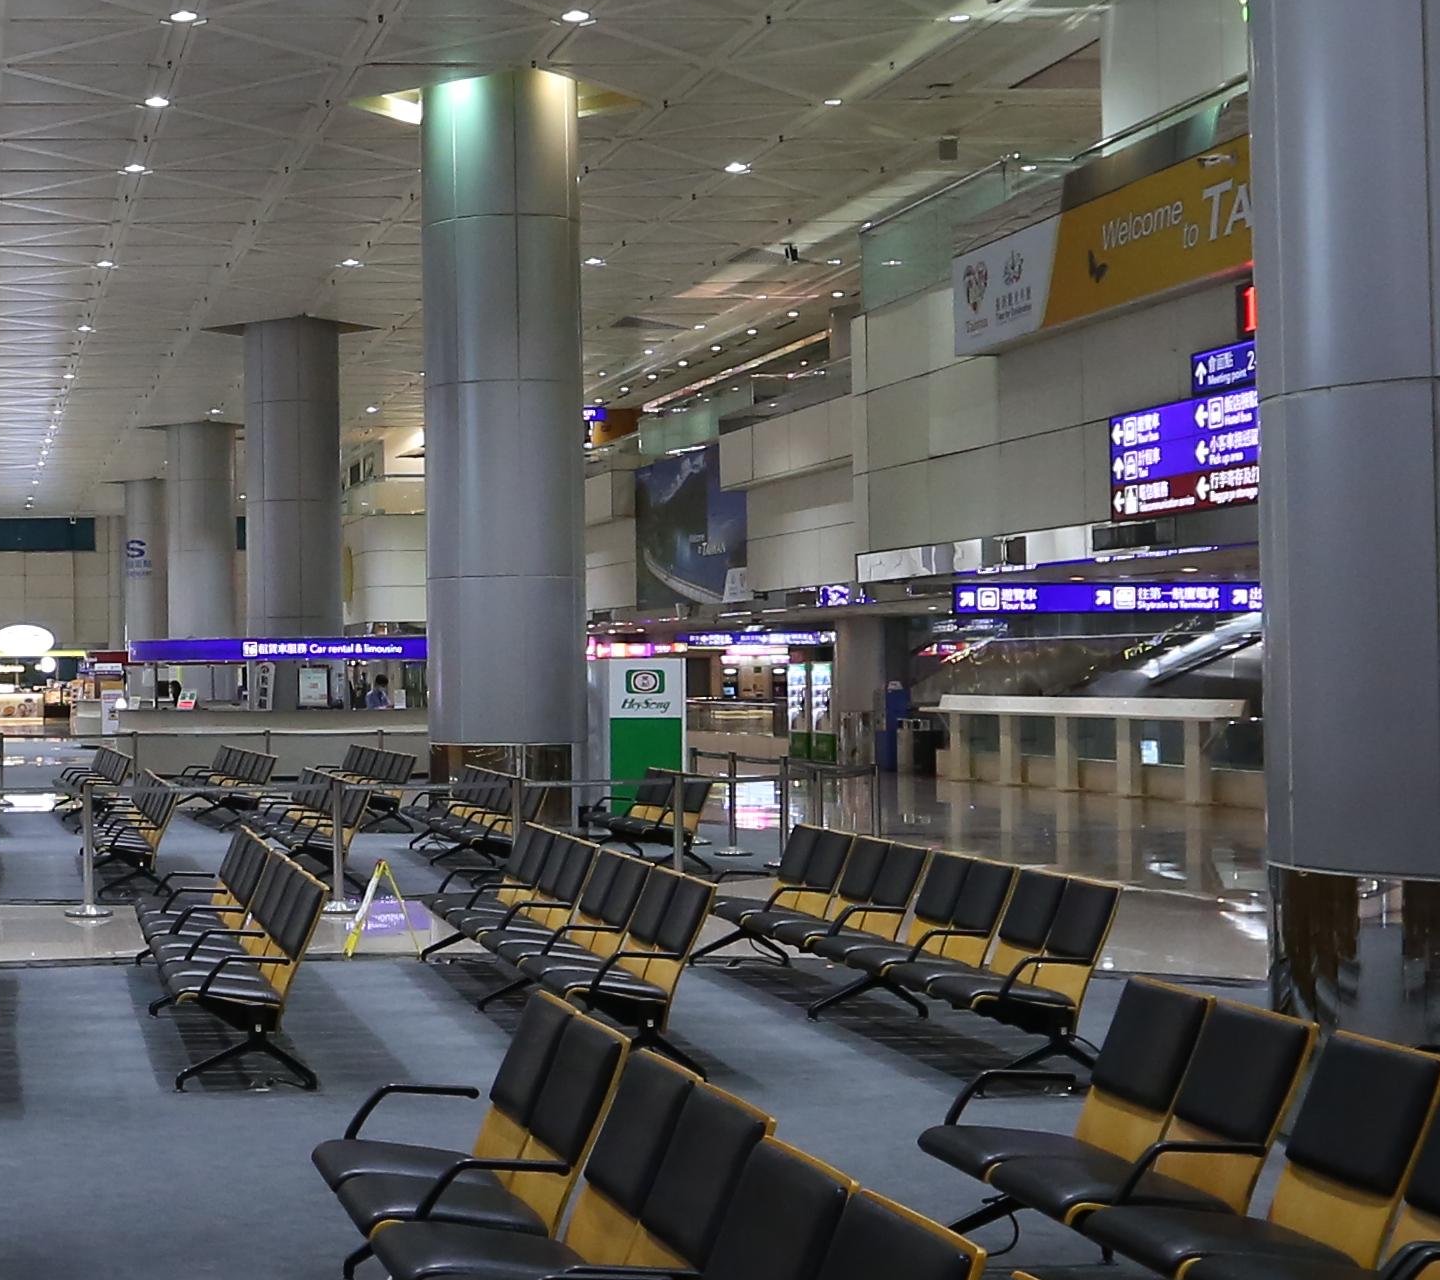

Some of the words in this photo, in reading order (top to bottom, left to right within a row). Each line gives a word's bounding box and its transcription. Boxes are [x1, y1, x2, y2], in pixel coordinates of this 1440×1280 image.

[1102, 201, 1183, 250] Welcome
[1182, 223, 1199, 248] to
[1208, 351, 1234, 374] 會面點
[1208, 372, 1230, 386] Meeting
[1231, 368, 1247, 383] point
[1001, 588, 1038, 601] 遊覽車
[1002, 601, 1019, 610] Tour
[1020, 601, 1036, 610] bus
[1137, 601, 1169, 611] Skytrain
[1169, 601, 1178, 609] to
[1179, 601, 1212, 609] Terminal
[1214, 601, 1219, 609] 1
[309, 644, 326, 654] Car
[328, 643, 353, 654] rental
[355, 644, 362, 653] &
[364, 644, 403, 654] limousine
